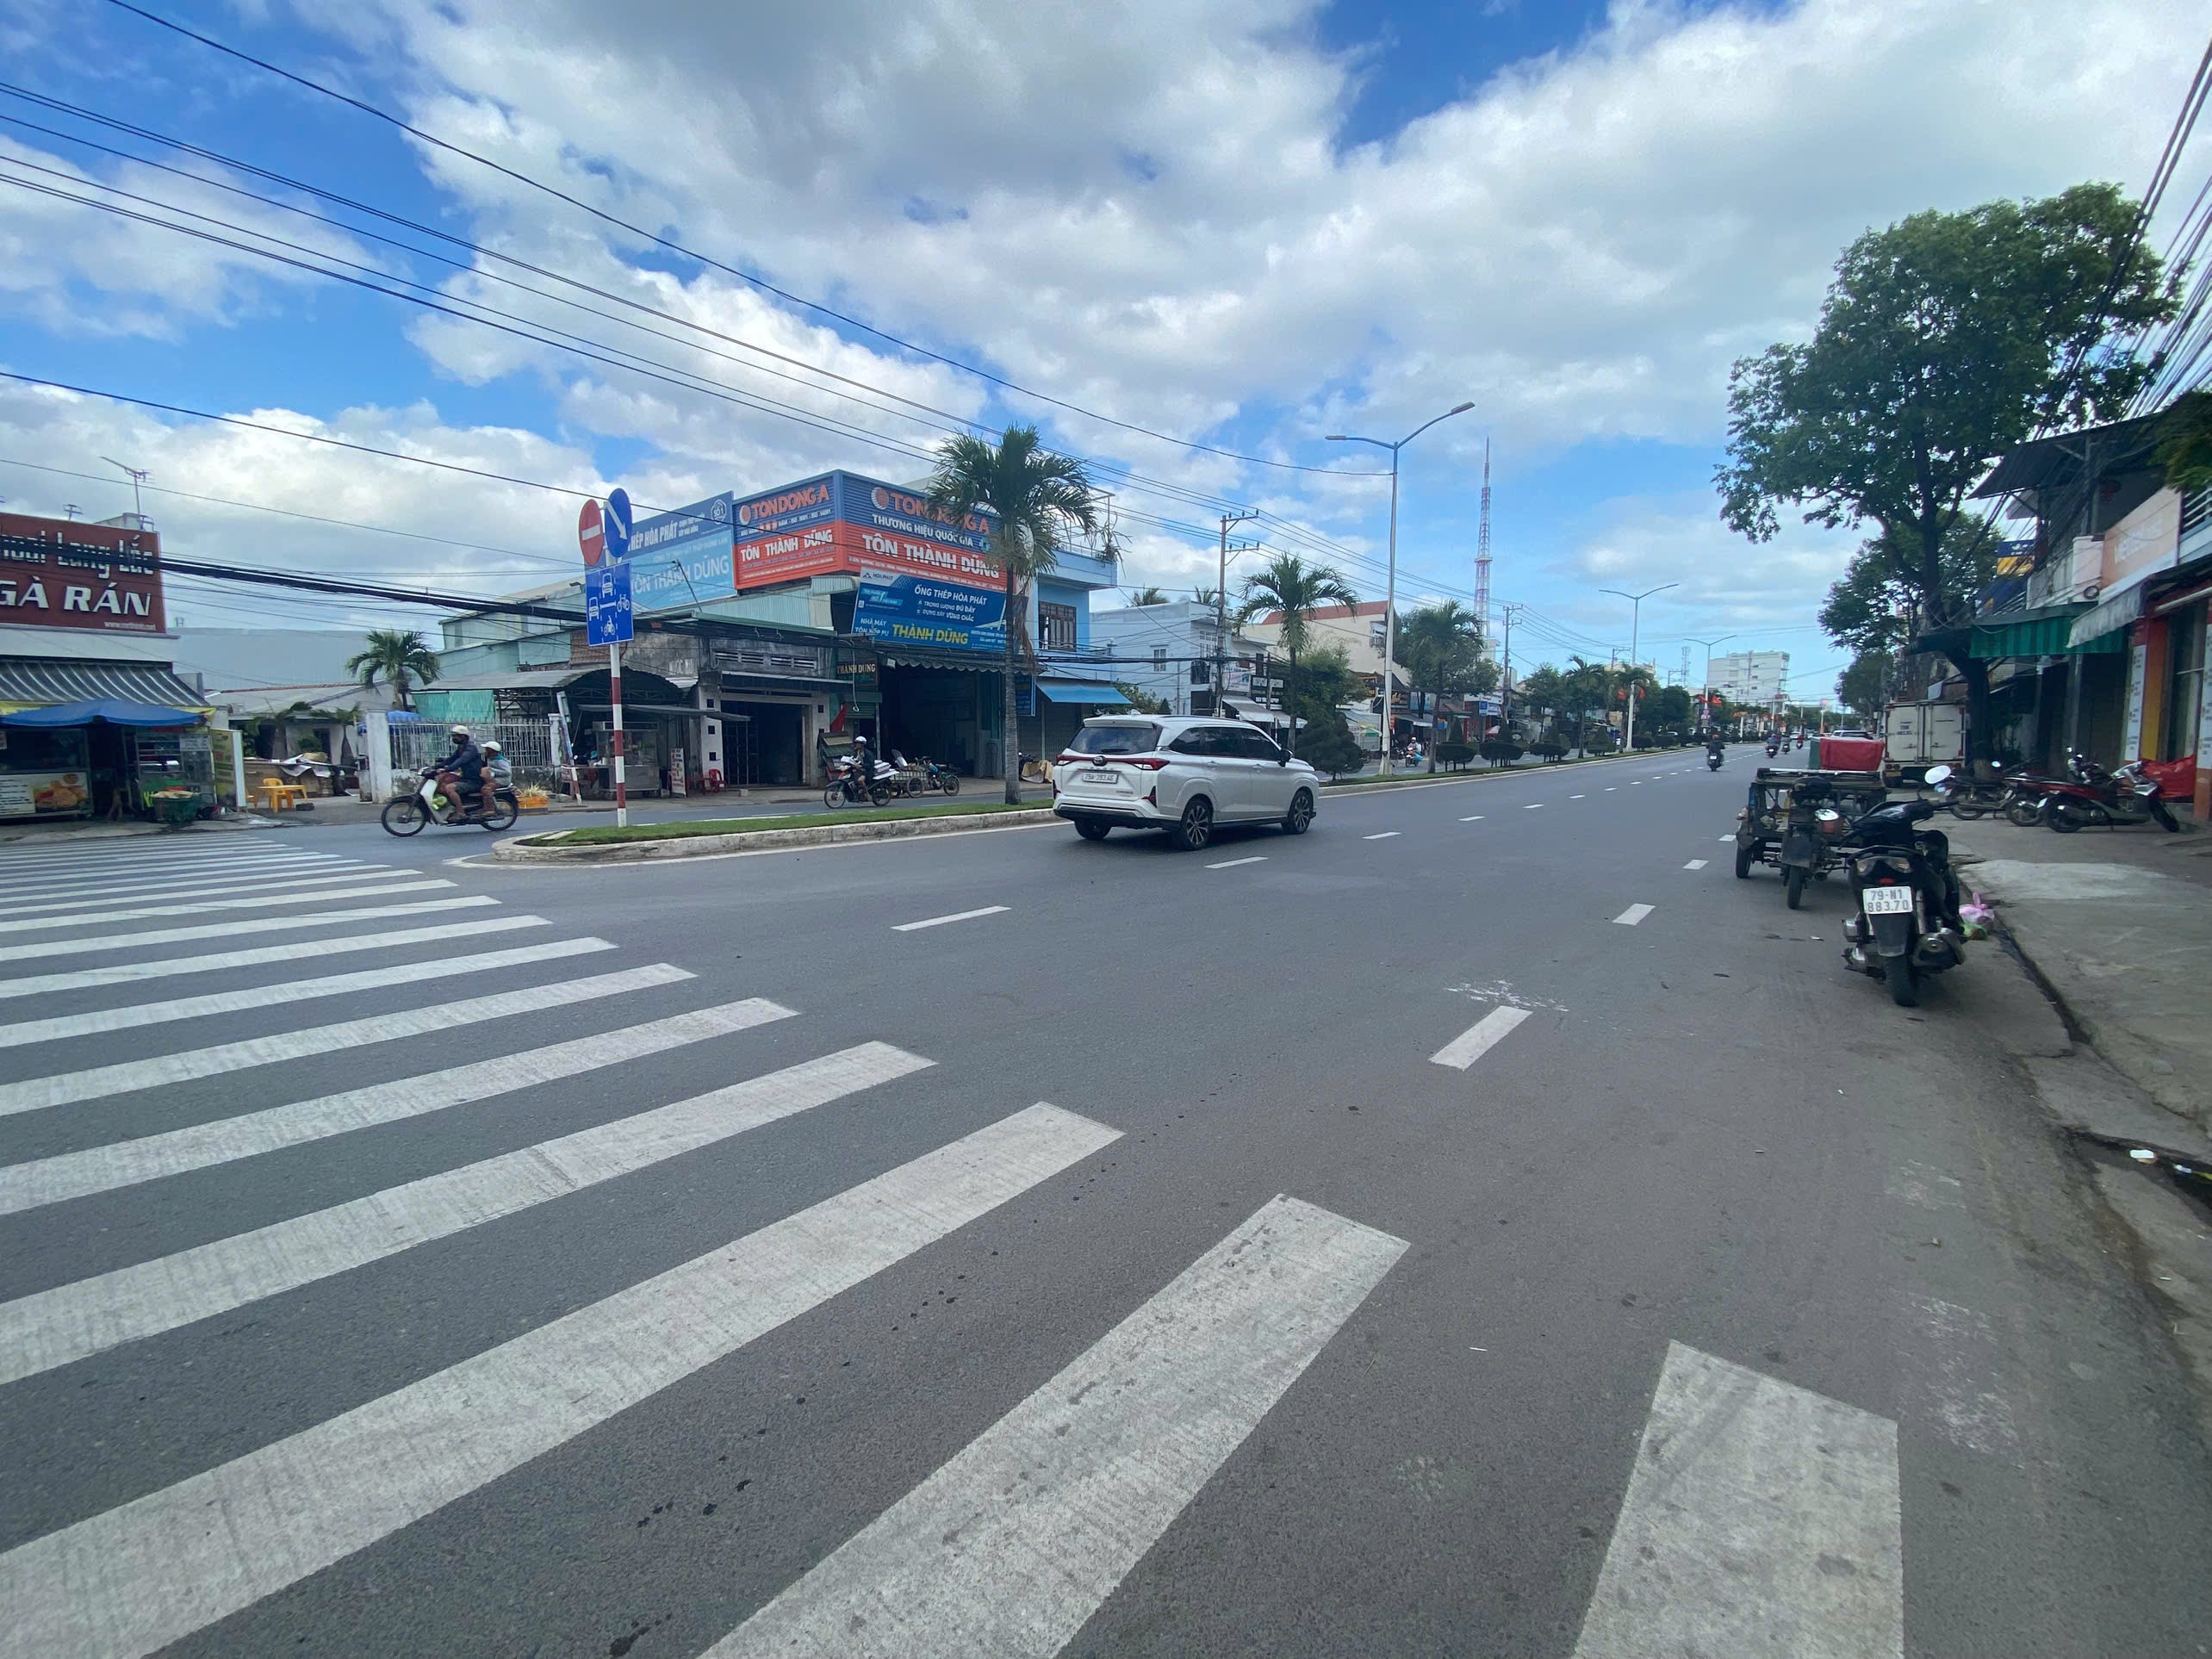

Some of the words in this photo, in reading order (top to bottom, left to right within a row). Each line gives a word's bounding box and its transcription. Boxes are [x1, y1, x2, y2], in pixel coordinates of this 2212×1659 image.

[628, 531, 643, 552] HÉP
[659, 519, 678, 543] PHÁT
[872, 513, 913, 533] THƯƠNG
[914, 523, 934, 538] HIỆU
[935, 528, 958, 543] QUỐC
[959, 535, 973, 547] GIA
[741, 544, 760, 562] TÔN
[765, 537, 798, 556] THÀNH
[804, 529, 833, 548] DŨNG
[862, 532, 898, 557] TÔN
[904, 544, 957, 570] THÀNH
[960, 554, 999, 579] DŨNG
[693, 555, 730, 581] DŨNG
[64, 581, 152, 616] RÁN
[914, 584, 932, 597] ỐNG
[934, 588, 953, 601] THÉP
[954, 592, 968, 602] HÒA
[969, 594, 987, 606] PHÁT
[892, 623, 935, 637] THÀNH
[935, 627, 968, 644] DŨNG
[1867, 900, 1909, 912] 883.70
[1870, 889, 1903, 901] 79-N1
